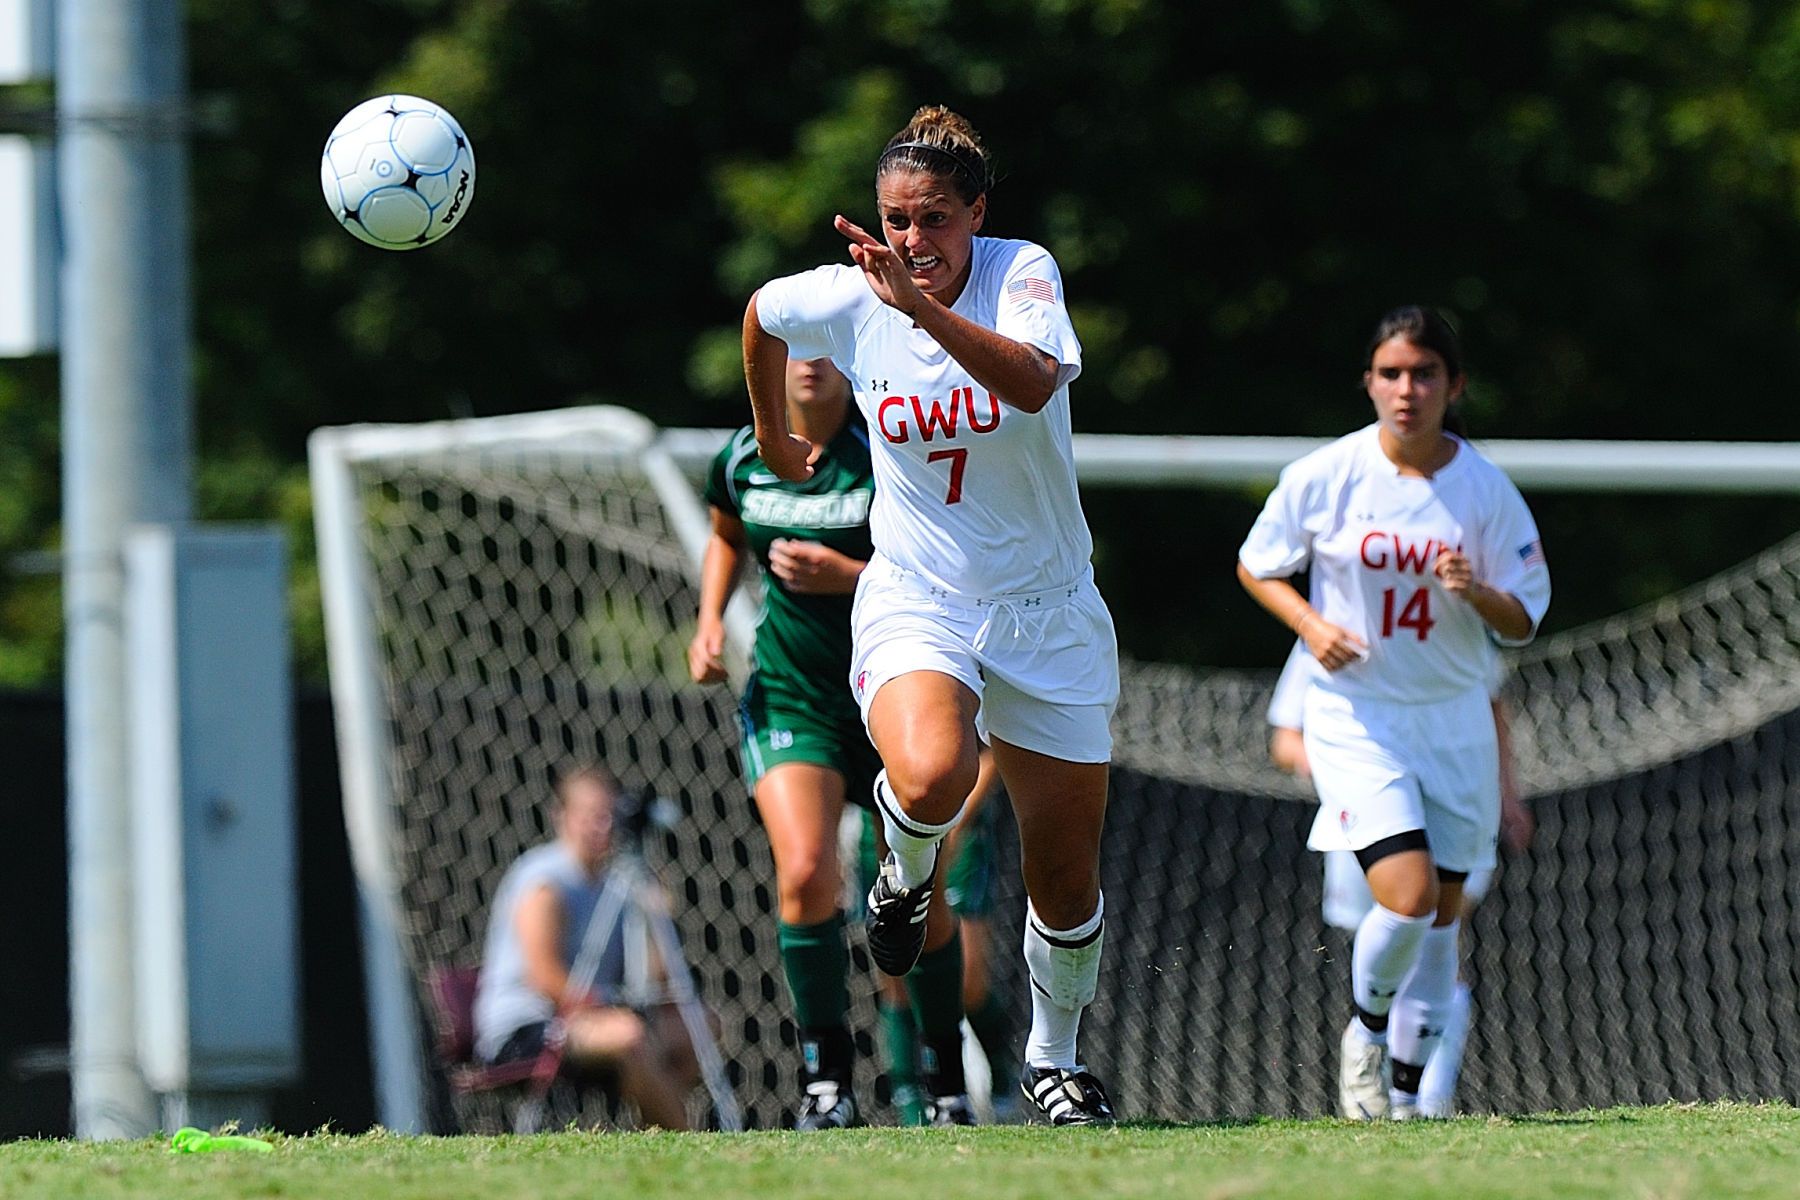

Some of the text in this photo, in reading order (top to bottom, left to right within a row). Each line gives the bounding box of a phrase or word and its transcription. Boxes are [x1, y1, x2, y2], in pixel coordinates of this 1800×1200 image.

[441, 169, 470, 224] NCAA
[878, 387, 1001, 444] GWU
[927, 448, 968, 505] 7
[1360, 531, 1462, 576] GW
[1382, 586, 1435, 641] 14
